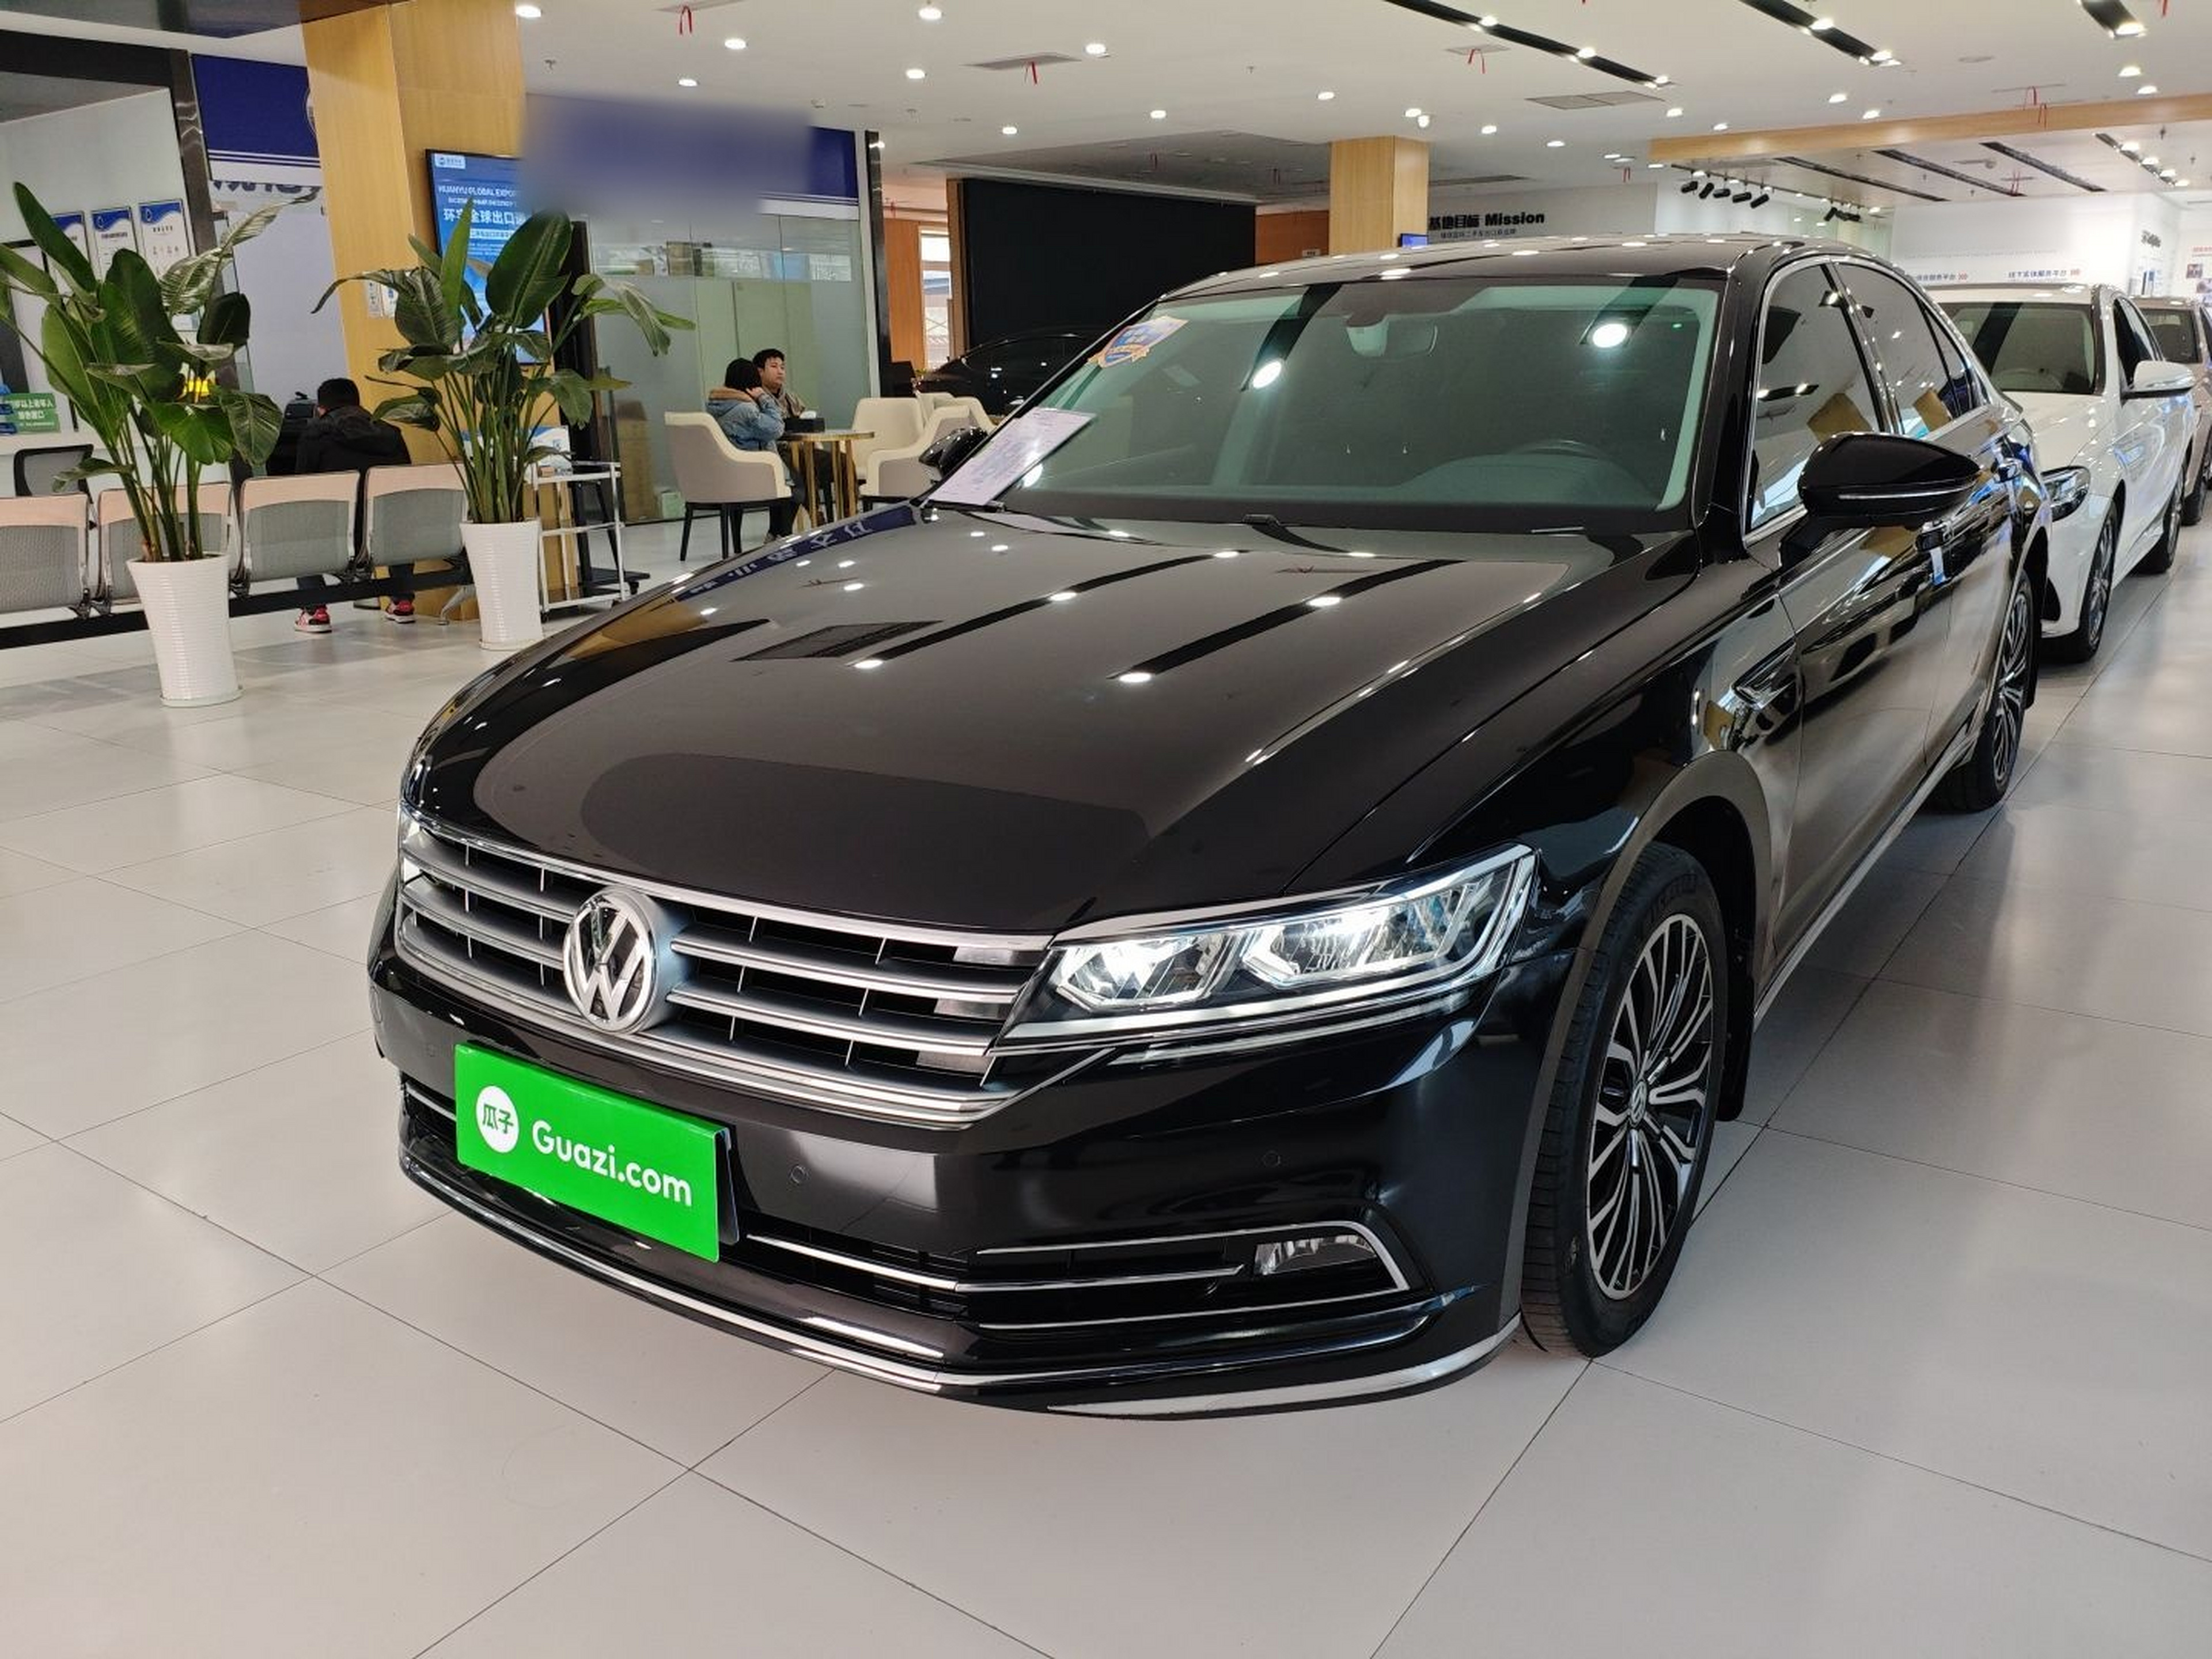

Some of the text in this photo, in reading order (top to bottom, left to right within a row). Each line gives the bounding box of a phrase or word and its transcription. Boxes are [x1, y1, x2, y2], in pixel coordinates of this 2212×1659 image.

[1485, 212, 1544, 226] Mission
[483, 1104, 692, 1206] 瓜子 Guazi.com
